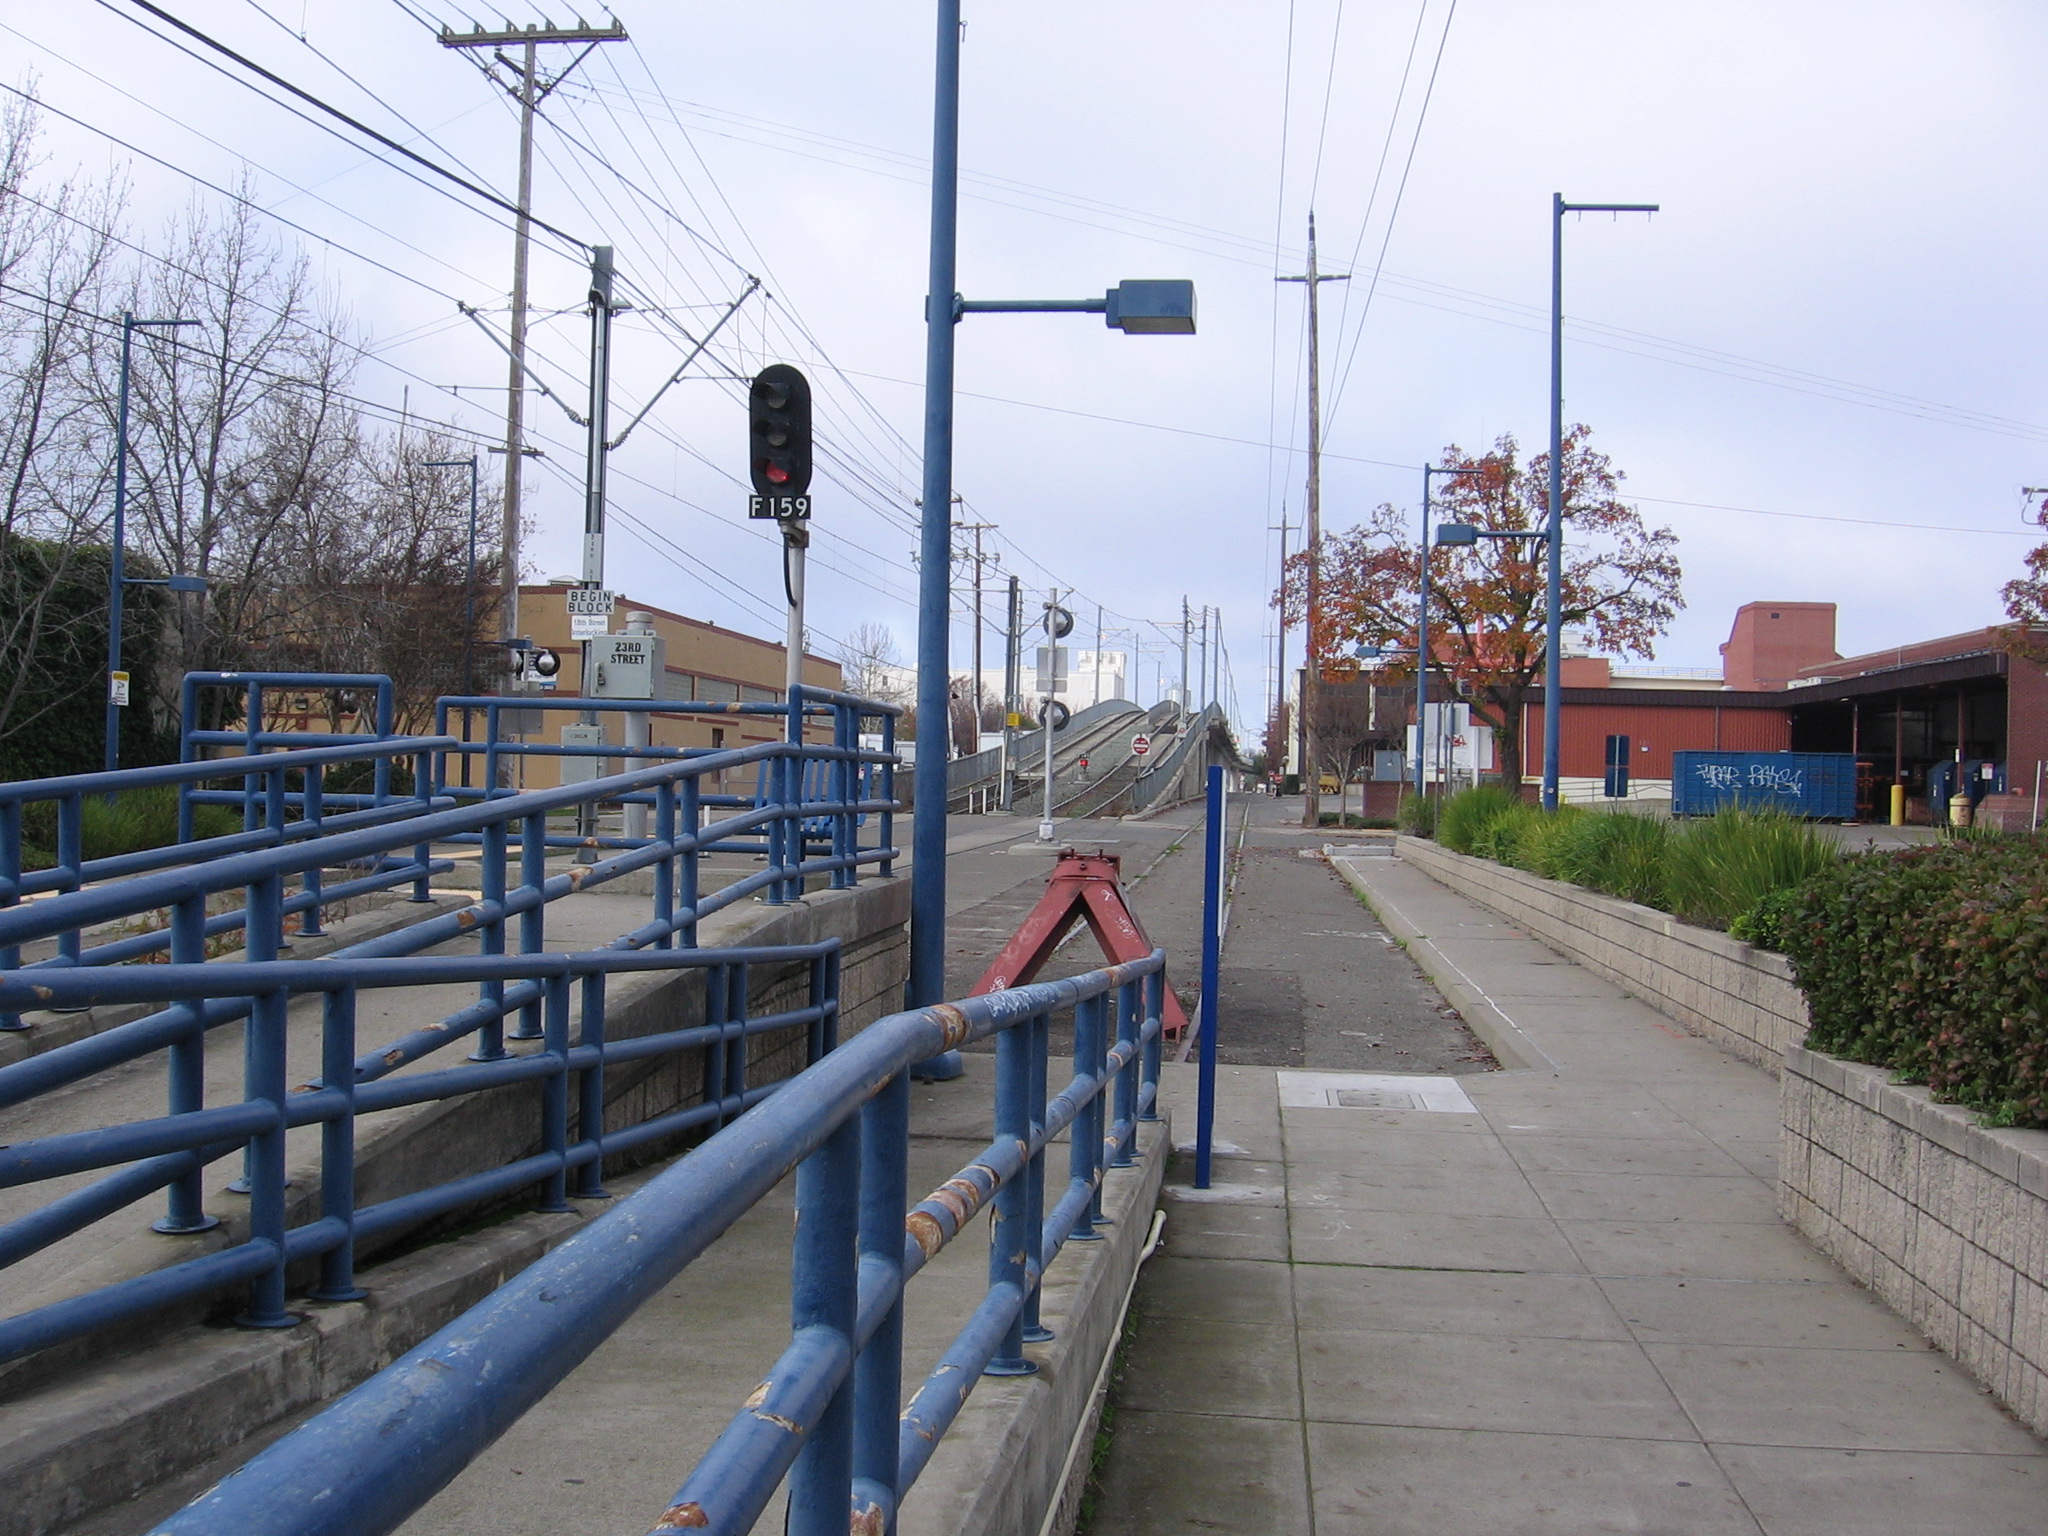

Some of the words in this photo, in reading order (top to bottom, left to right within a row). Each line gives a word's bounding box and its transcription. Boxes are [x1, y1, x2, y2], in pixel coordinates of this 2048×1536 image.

[571, 591, 611, 602] BEGIN
[568, 603, 612, 613] BLOCK
[615, 642, 641, 653] 23RD
[610, 653, 645, 665] STREET
